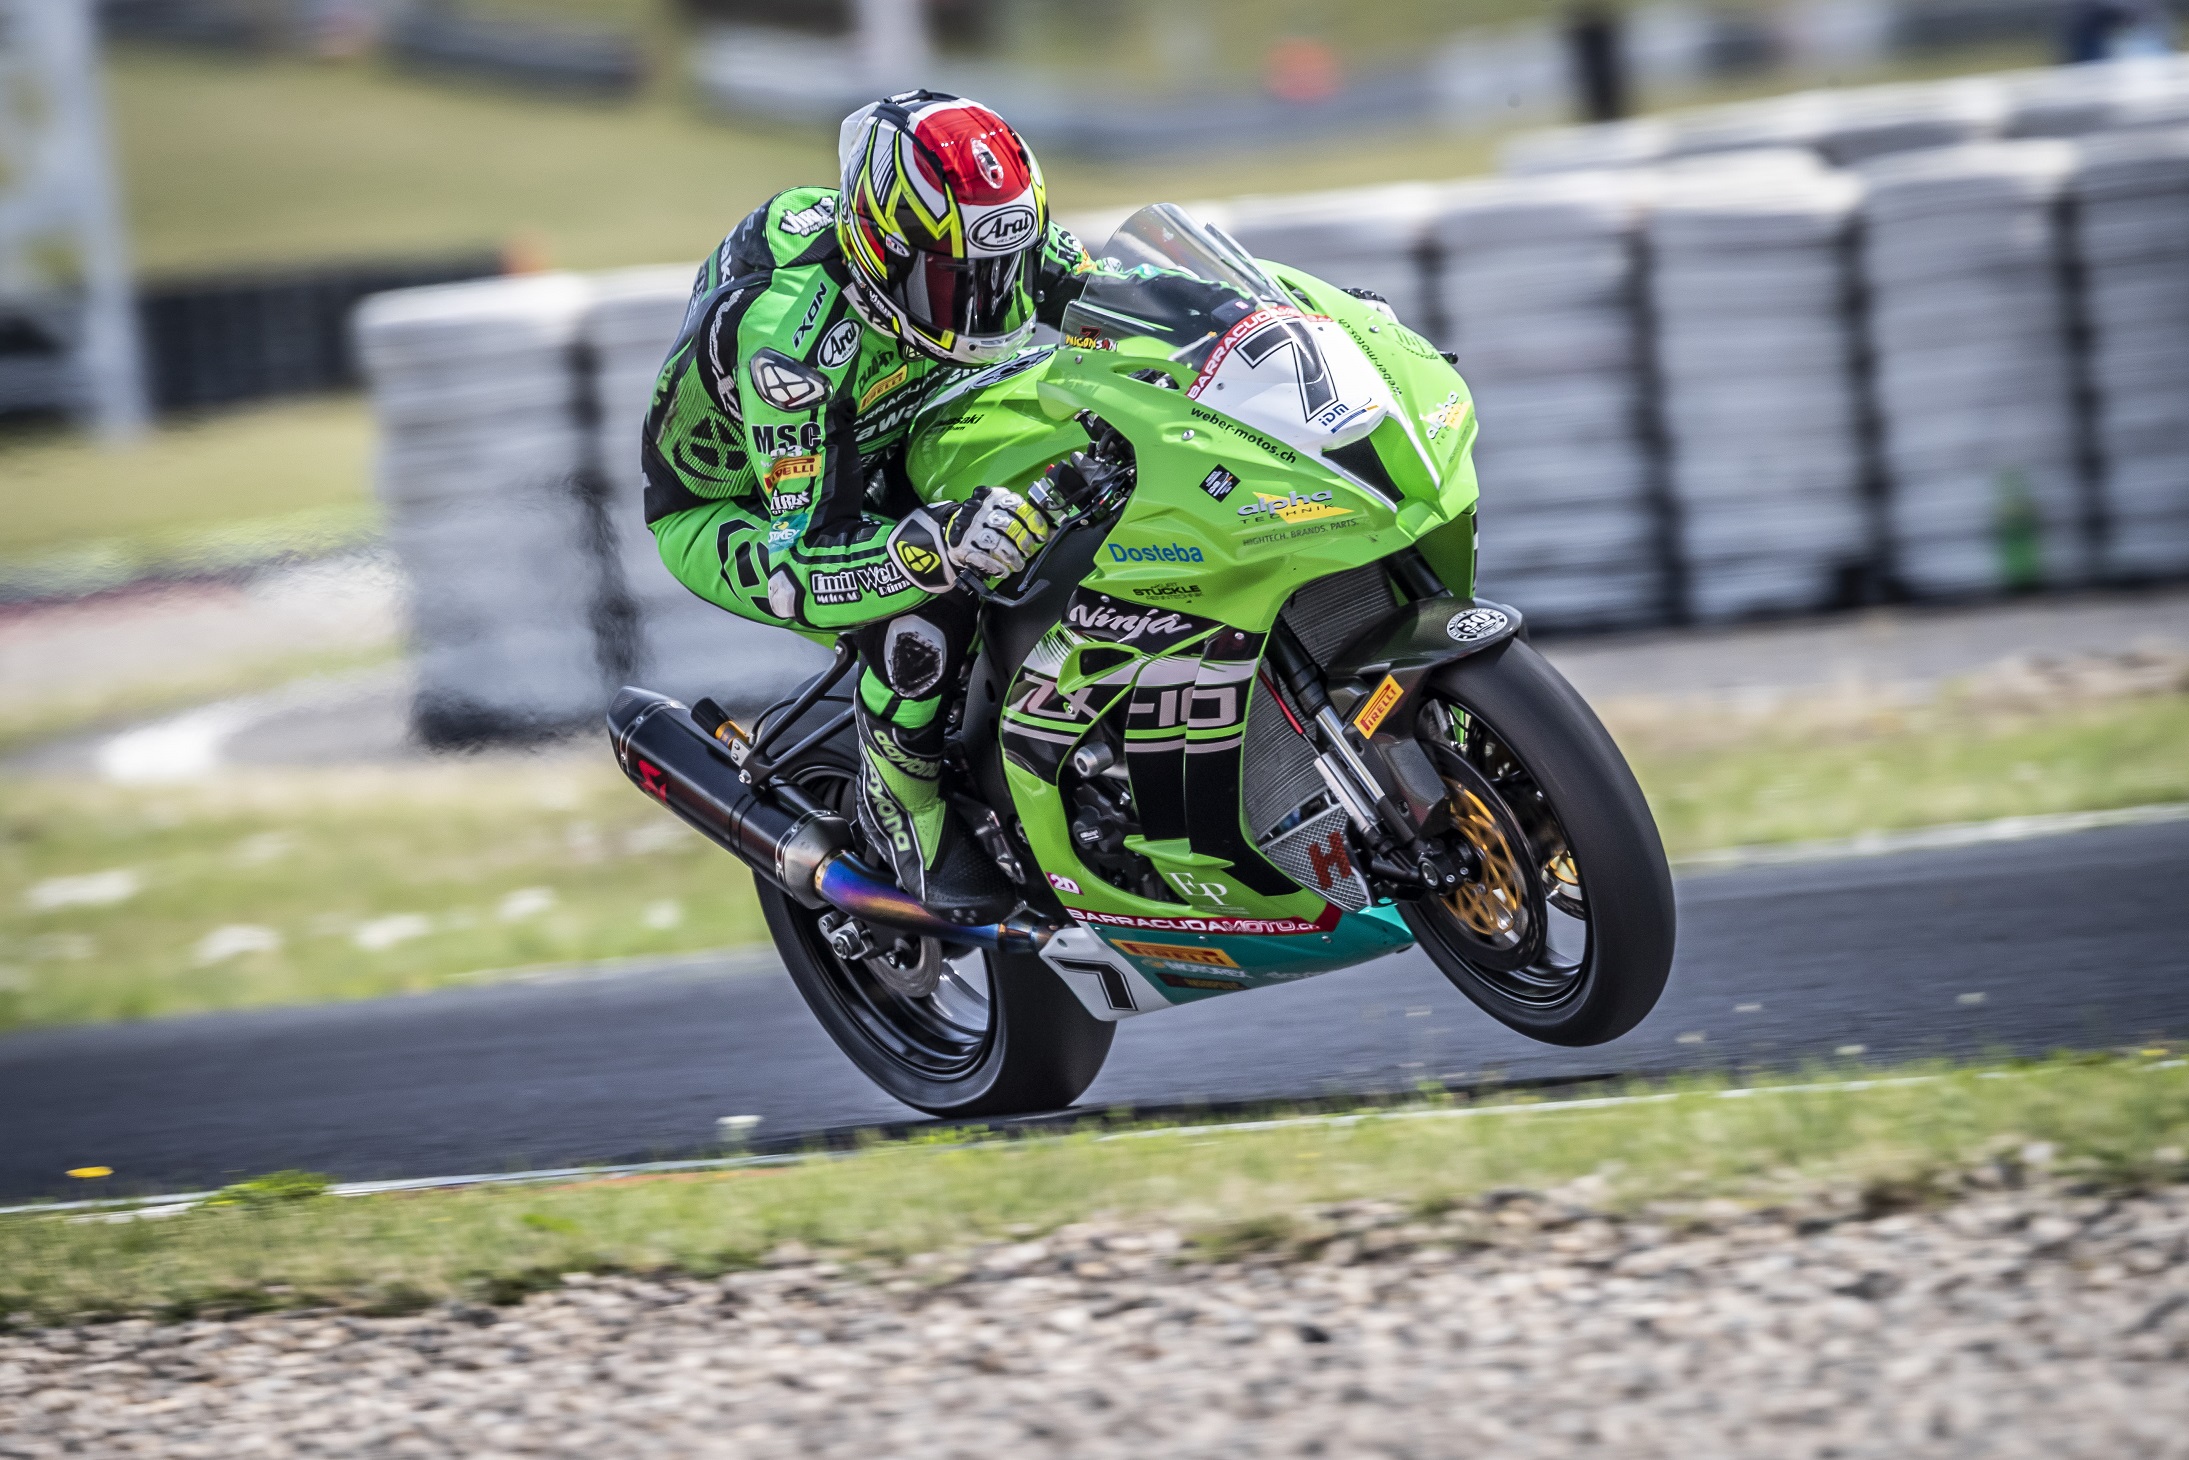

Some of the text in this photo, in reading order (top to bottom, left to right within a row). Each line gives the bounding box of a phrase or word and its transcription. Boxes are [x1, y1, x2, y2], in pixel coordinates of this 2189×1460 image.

[978, 211, 1030, 241] Arai
[827, 319, 861, 367] Arai
[1234, 315, 1339, 423] 7
[752, 422, 823, 456] MSC
[1190, 406, 1297, 465] weber-motos.ch
[1237, 490, 1334, 517] alpha
[1240, 503, 1335, 525] TECHNIK
[1107, 542, 1205, 564] Dosteba
[1069, 602, 1193, 643] Ninja
[1457, 613, 1492, 633] 30
[1360, 684, 1397, 732] PIRELLI
[1047, 955, 1139, 1012] 7
